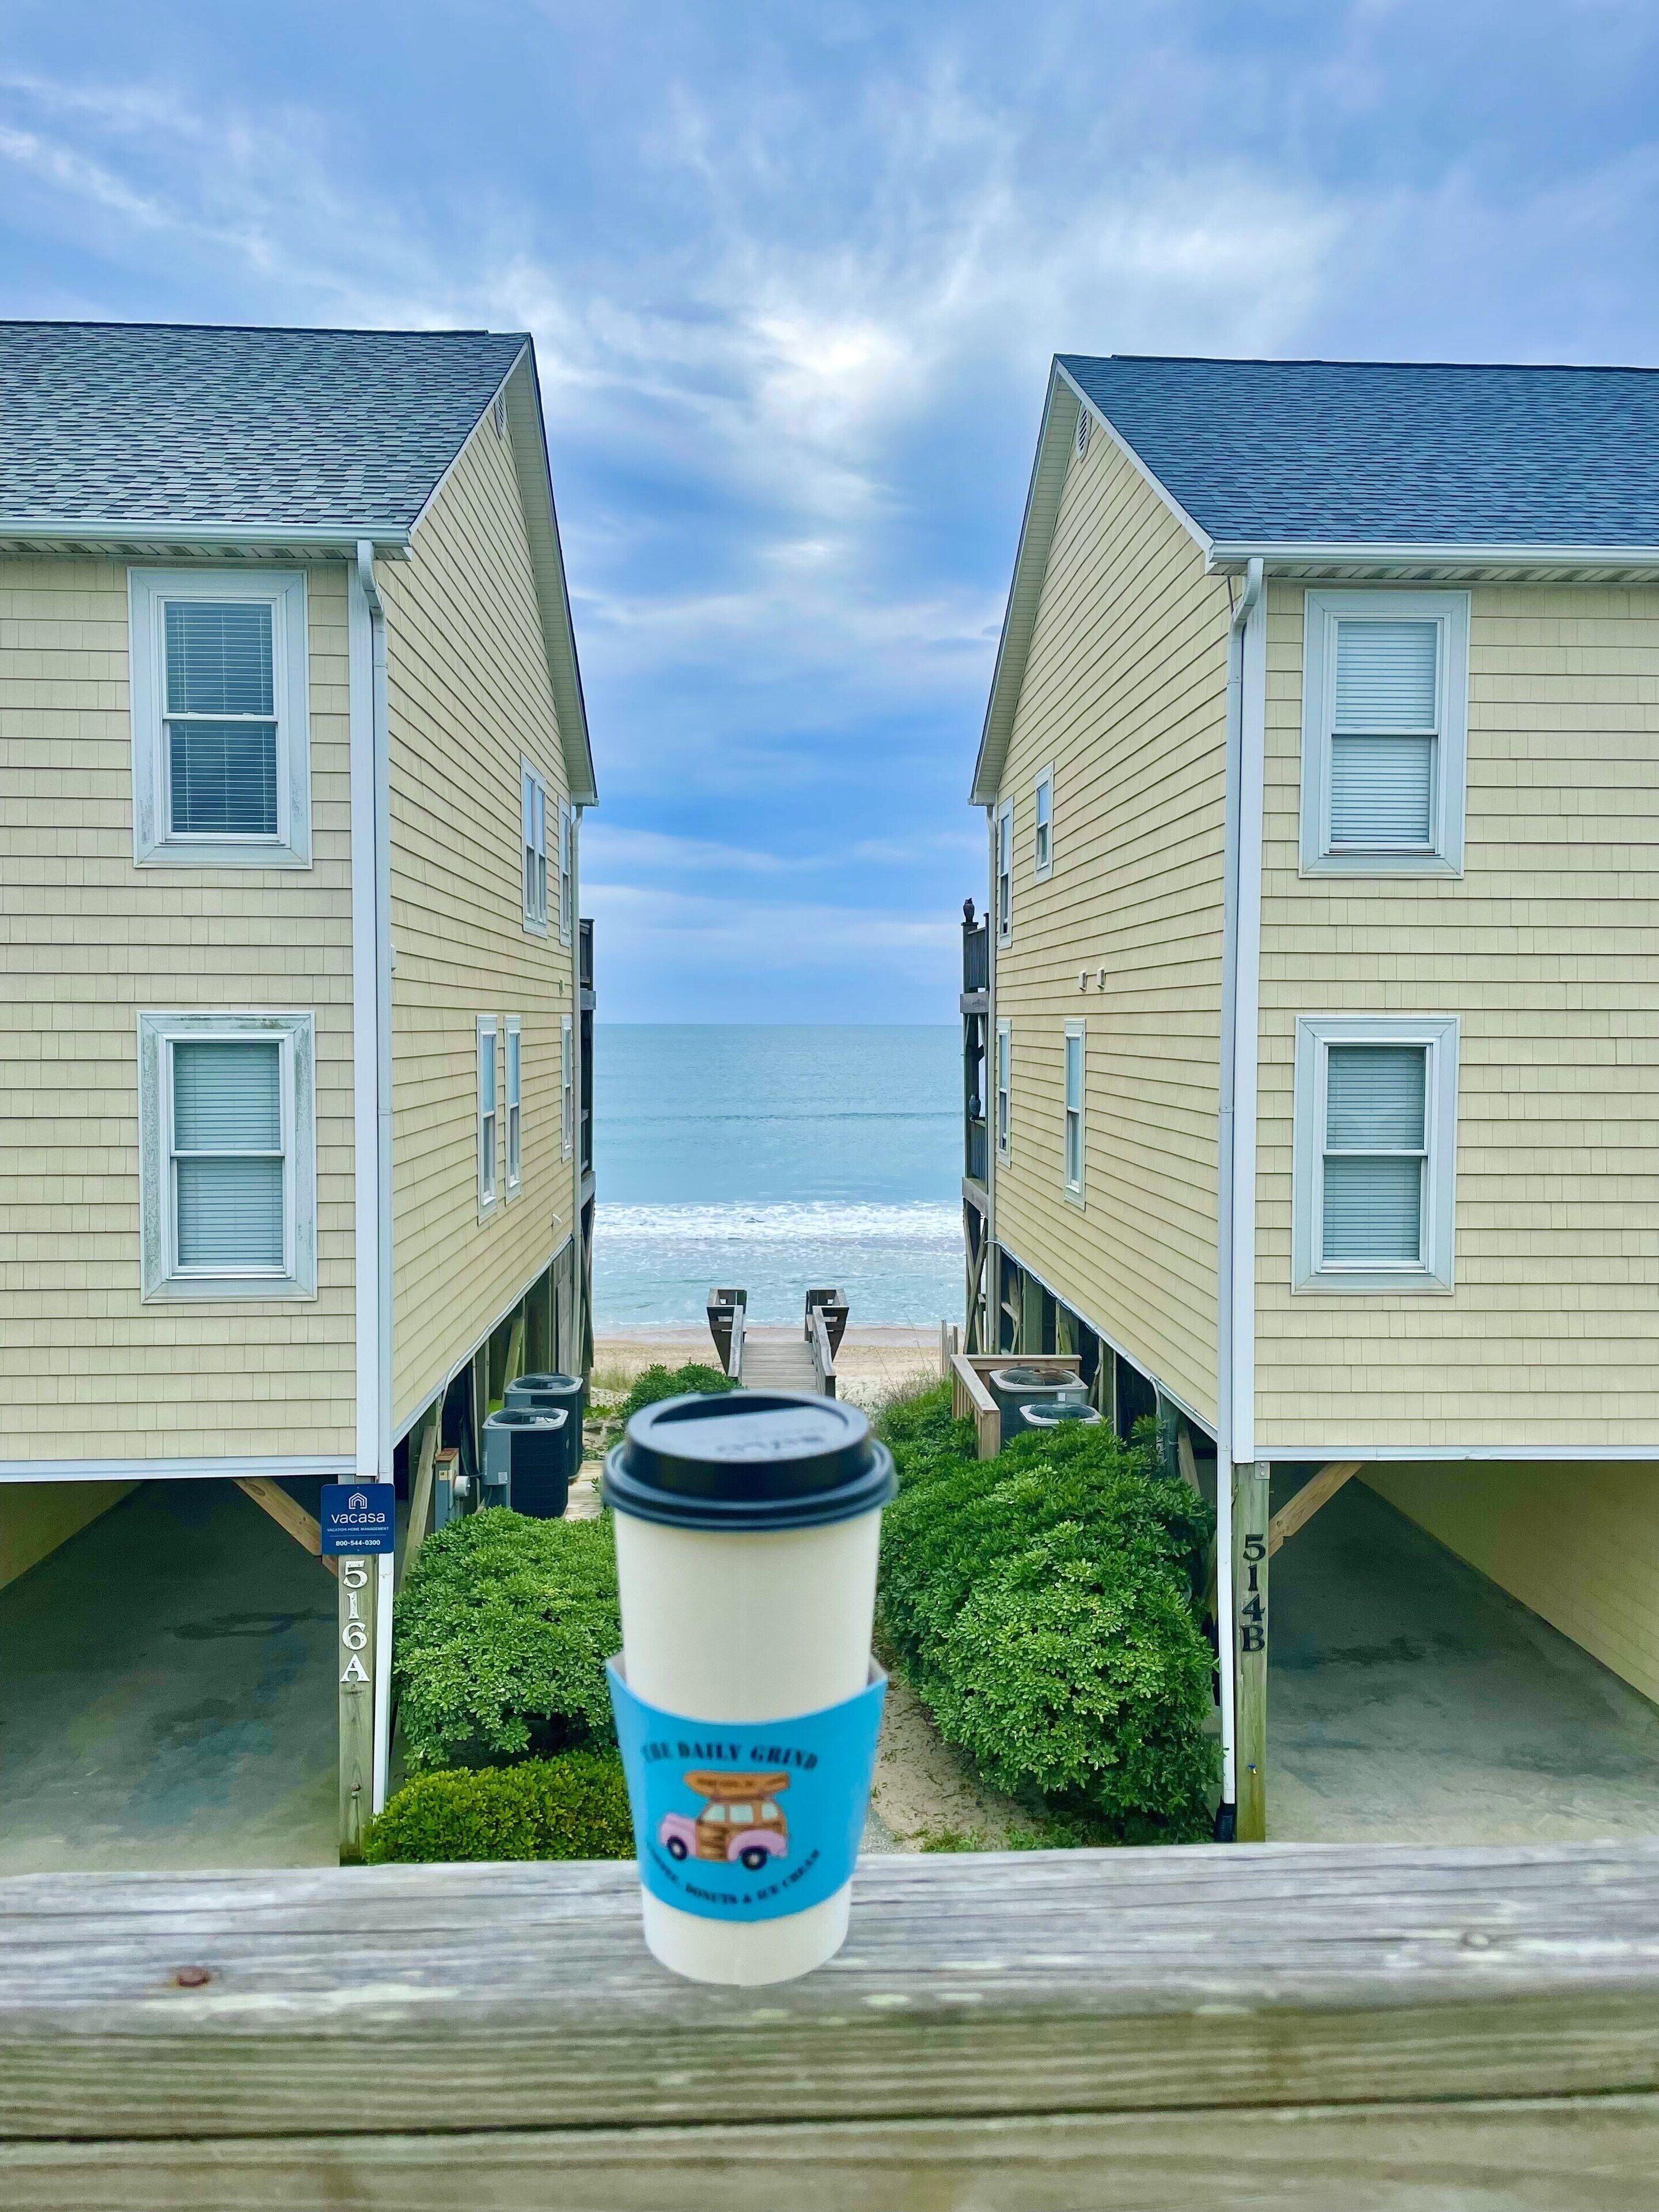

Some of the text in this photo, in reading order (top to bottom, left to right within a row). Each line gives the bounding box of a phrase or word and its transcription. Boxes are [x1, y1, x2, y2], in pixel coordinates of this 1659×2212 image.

[331, 1513, 385, 1524] vacasa
[340, 1560, 370, 1682] 516A
[1241, 1533, 1266, 1652] 514B
[677, 1741, 741, 1761] DAILY
[750, 1744, 819, 1770] GRIND
